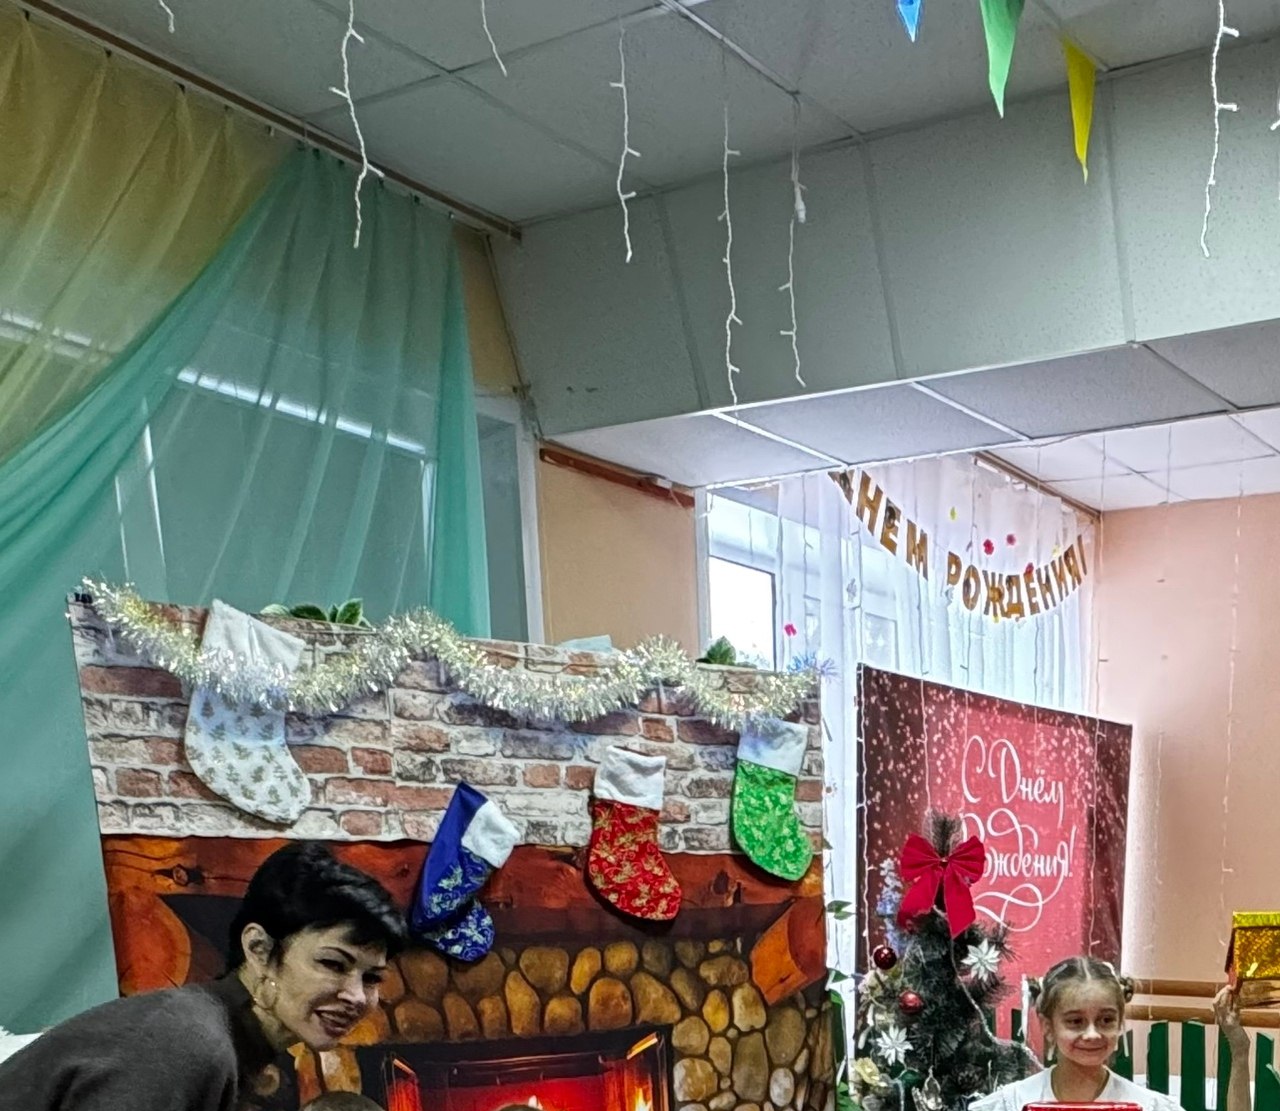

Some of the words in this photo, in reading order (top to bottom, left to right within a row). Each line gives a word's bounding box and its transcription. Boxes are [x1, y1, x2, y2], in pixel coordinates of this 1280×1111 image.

[947, 535, 1087, 618] РОЖДЕНИЯ!
[961, 735, 986, 804] С
[988, 738, 1064, 828] Днём
